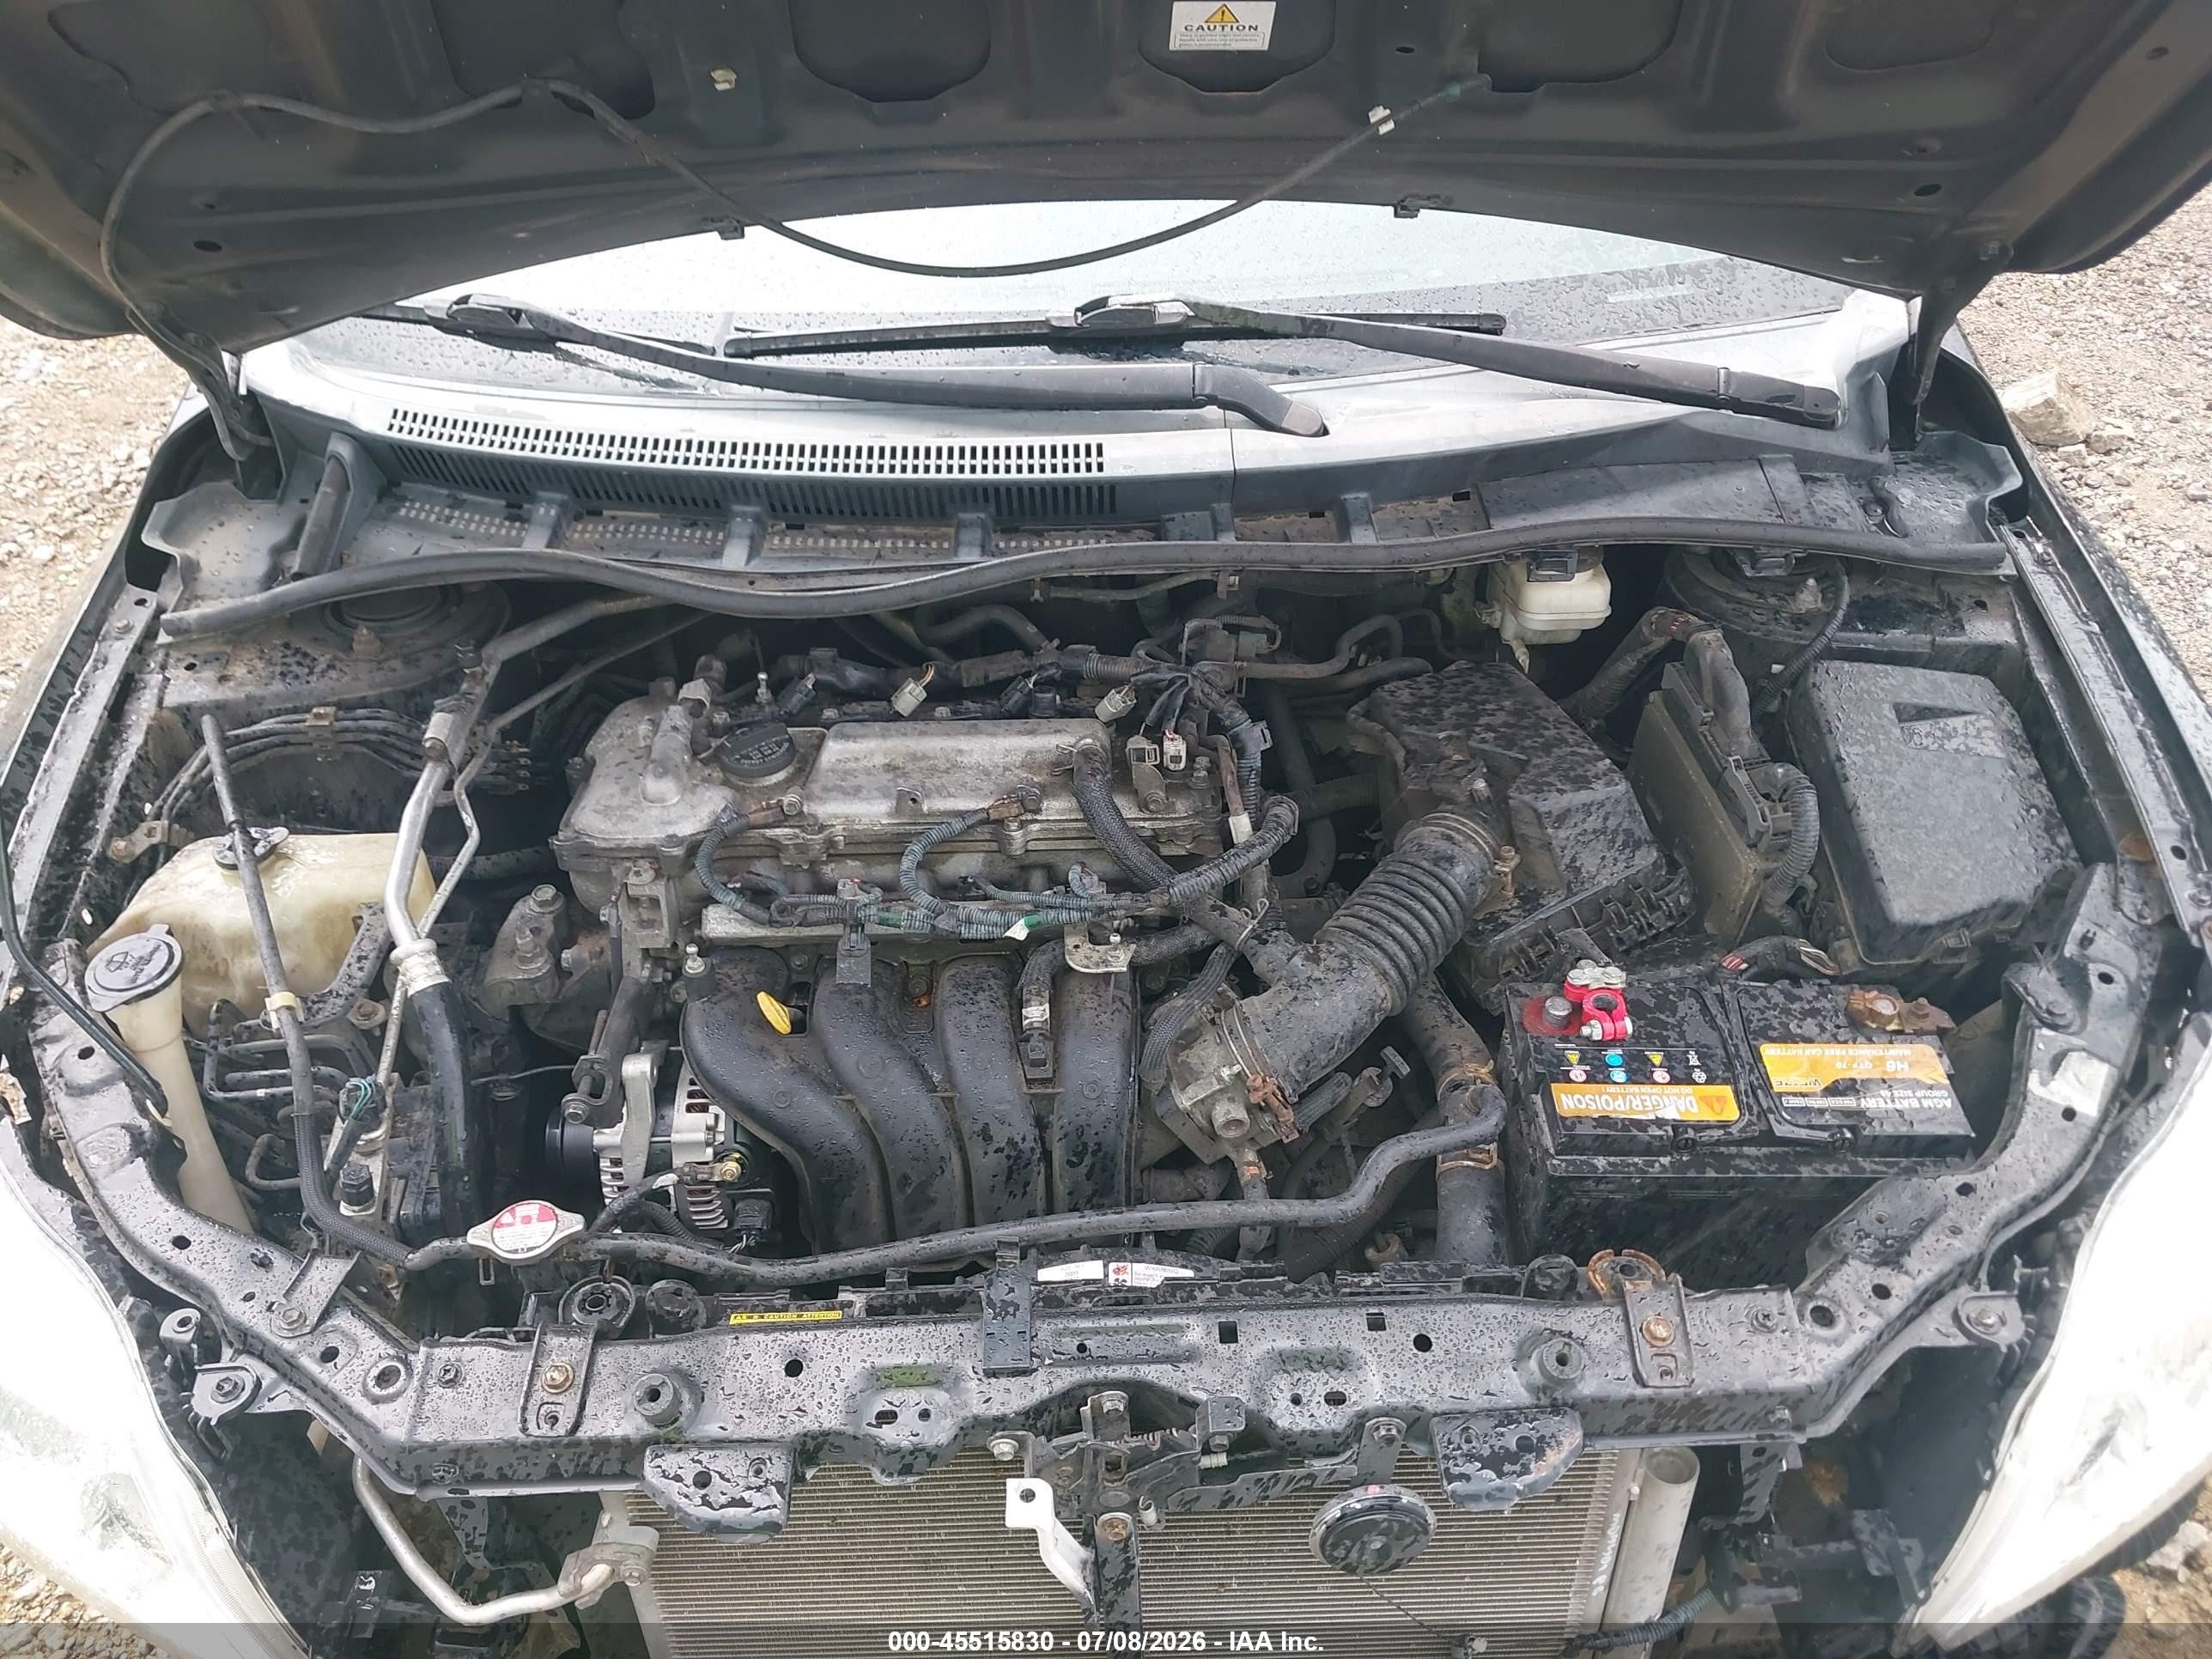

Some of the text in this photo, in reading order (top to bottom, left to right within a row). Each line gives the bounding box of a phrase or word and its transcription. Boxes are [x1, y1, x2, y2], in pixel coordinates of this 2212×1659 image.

[1886, 1061, 1909, 1072] H6
[1560, 1093, 1698, 1113] DANGER/POISON
[1860, 1097, 1919, 1109] BATTERY
[1922, 1097, 1952, 1109] AGM
[1144, 1265, 1179, 1274] WARNING
